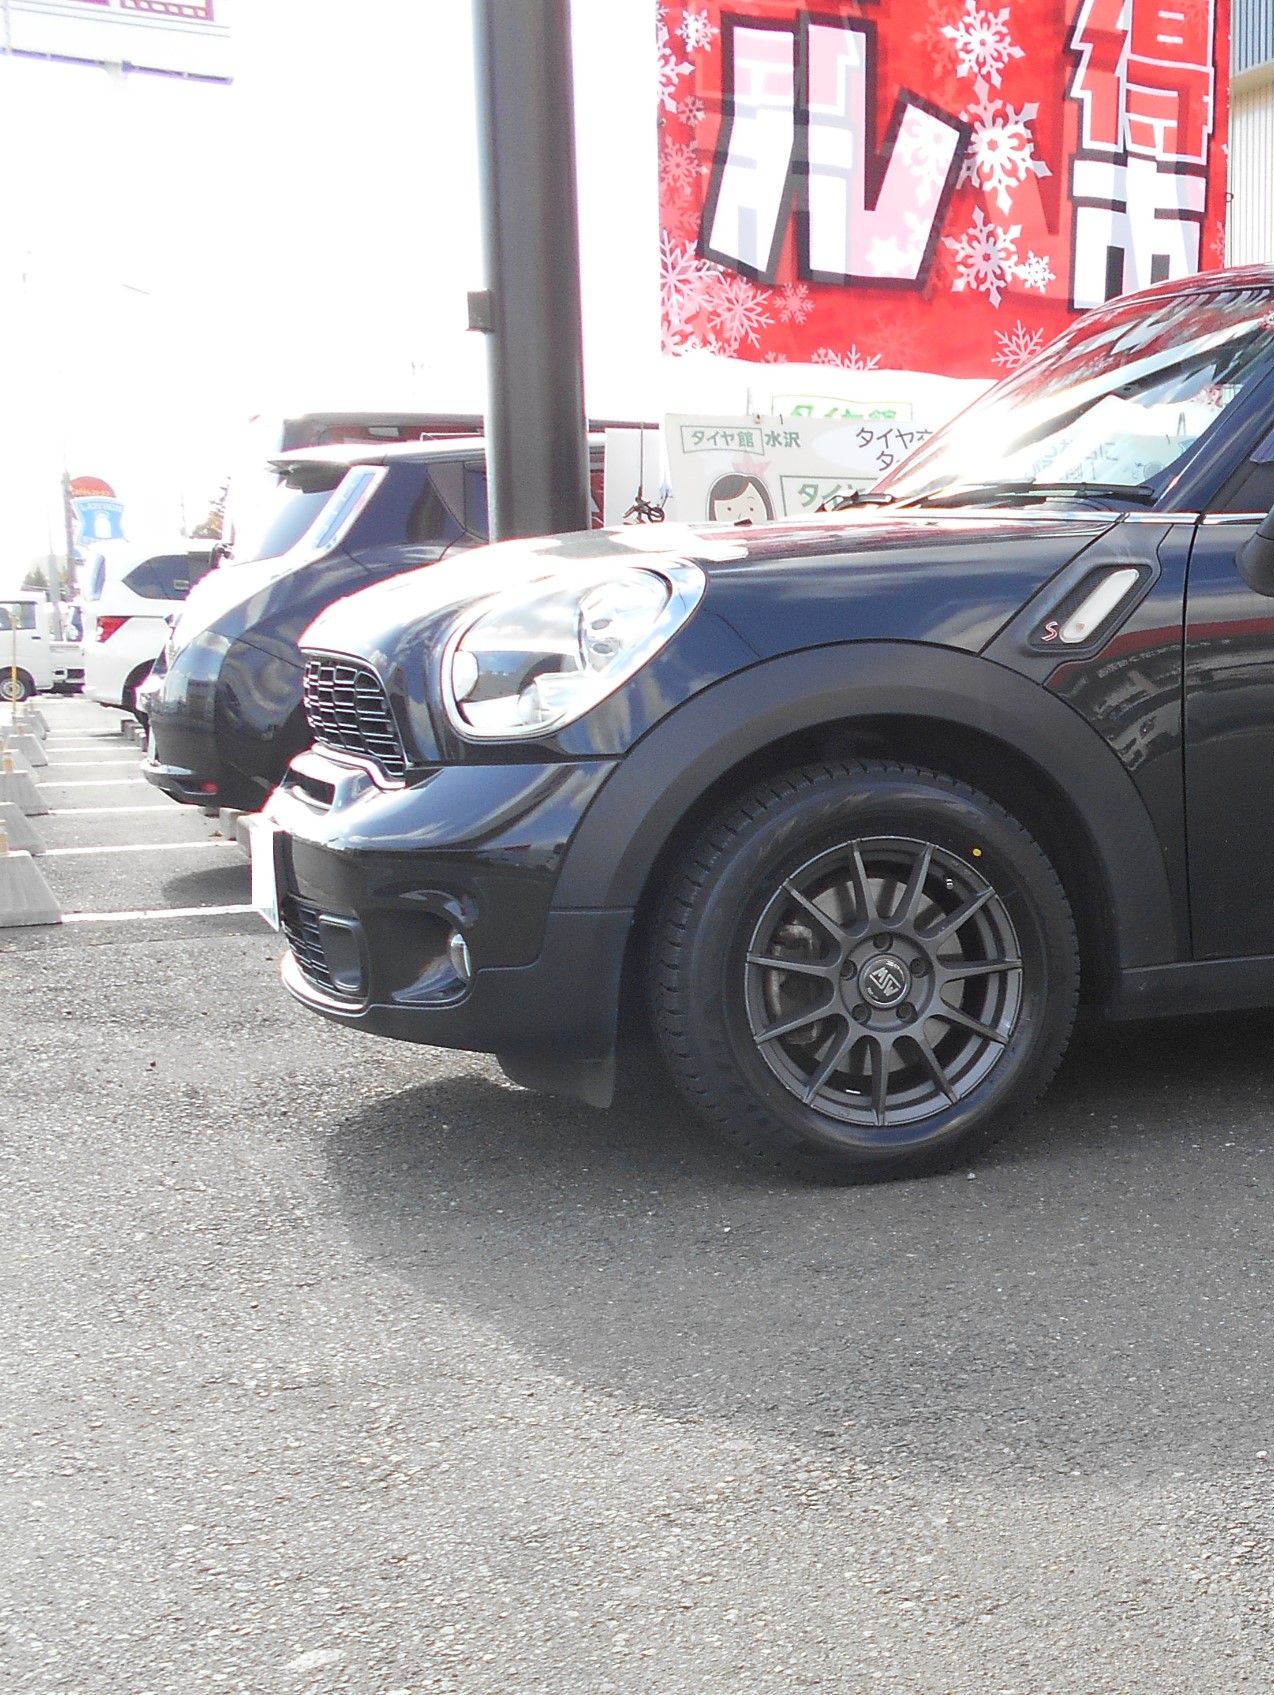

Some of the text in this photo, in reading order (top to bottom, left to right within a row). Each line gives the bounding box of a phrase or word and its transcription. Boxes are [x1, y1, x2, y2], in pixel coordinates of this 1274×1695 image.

[691, 430, 801, 448] タイヤ館 水沢
[1041, 621, 1058, 641] S
